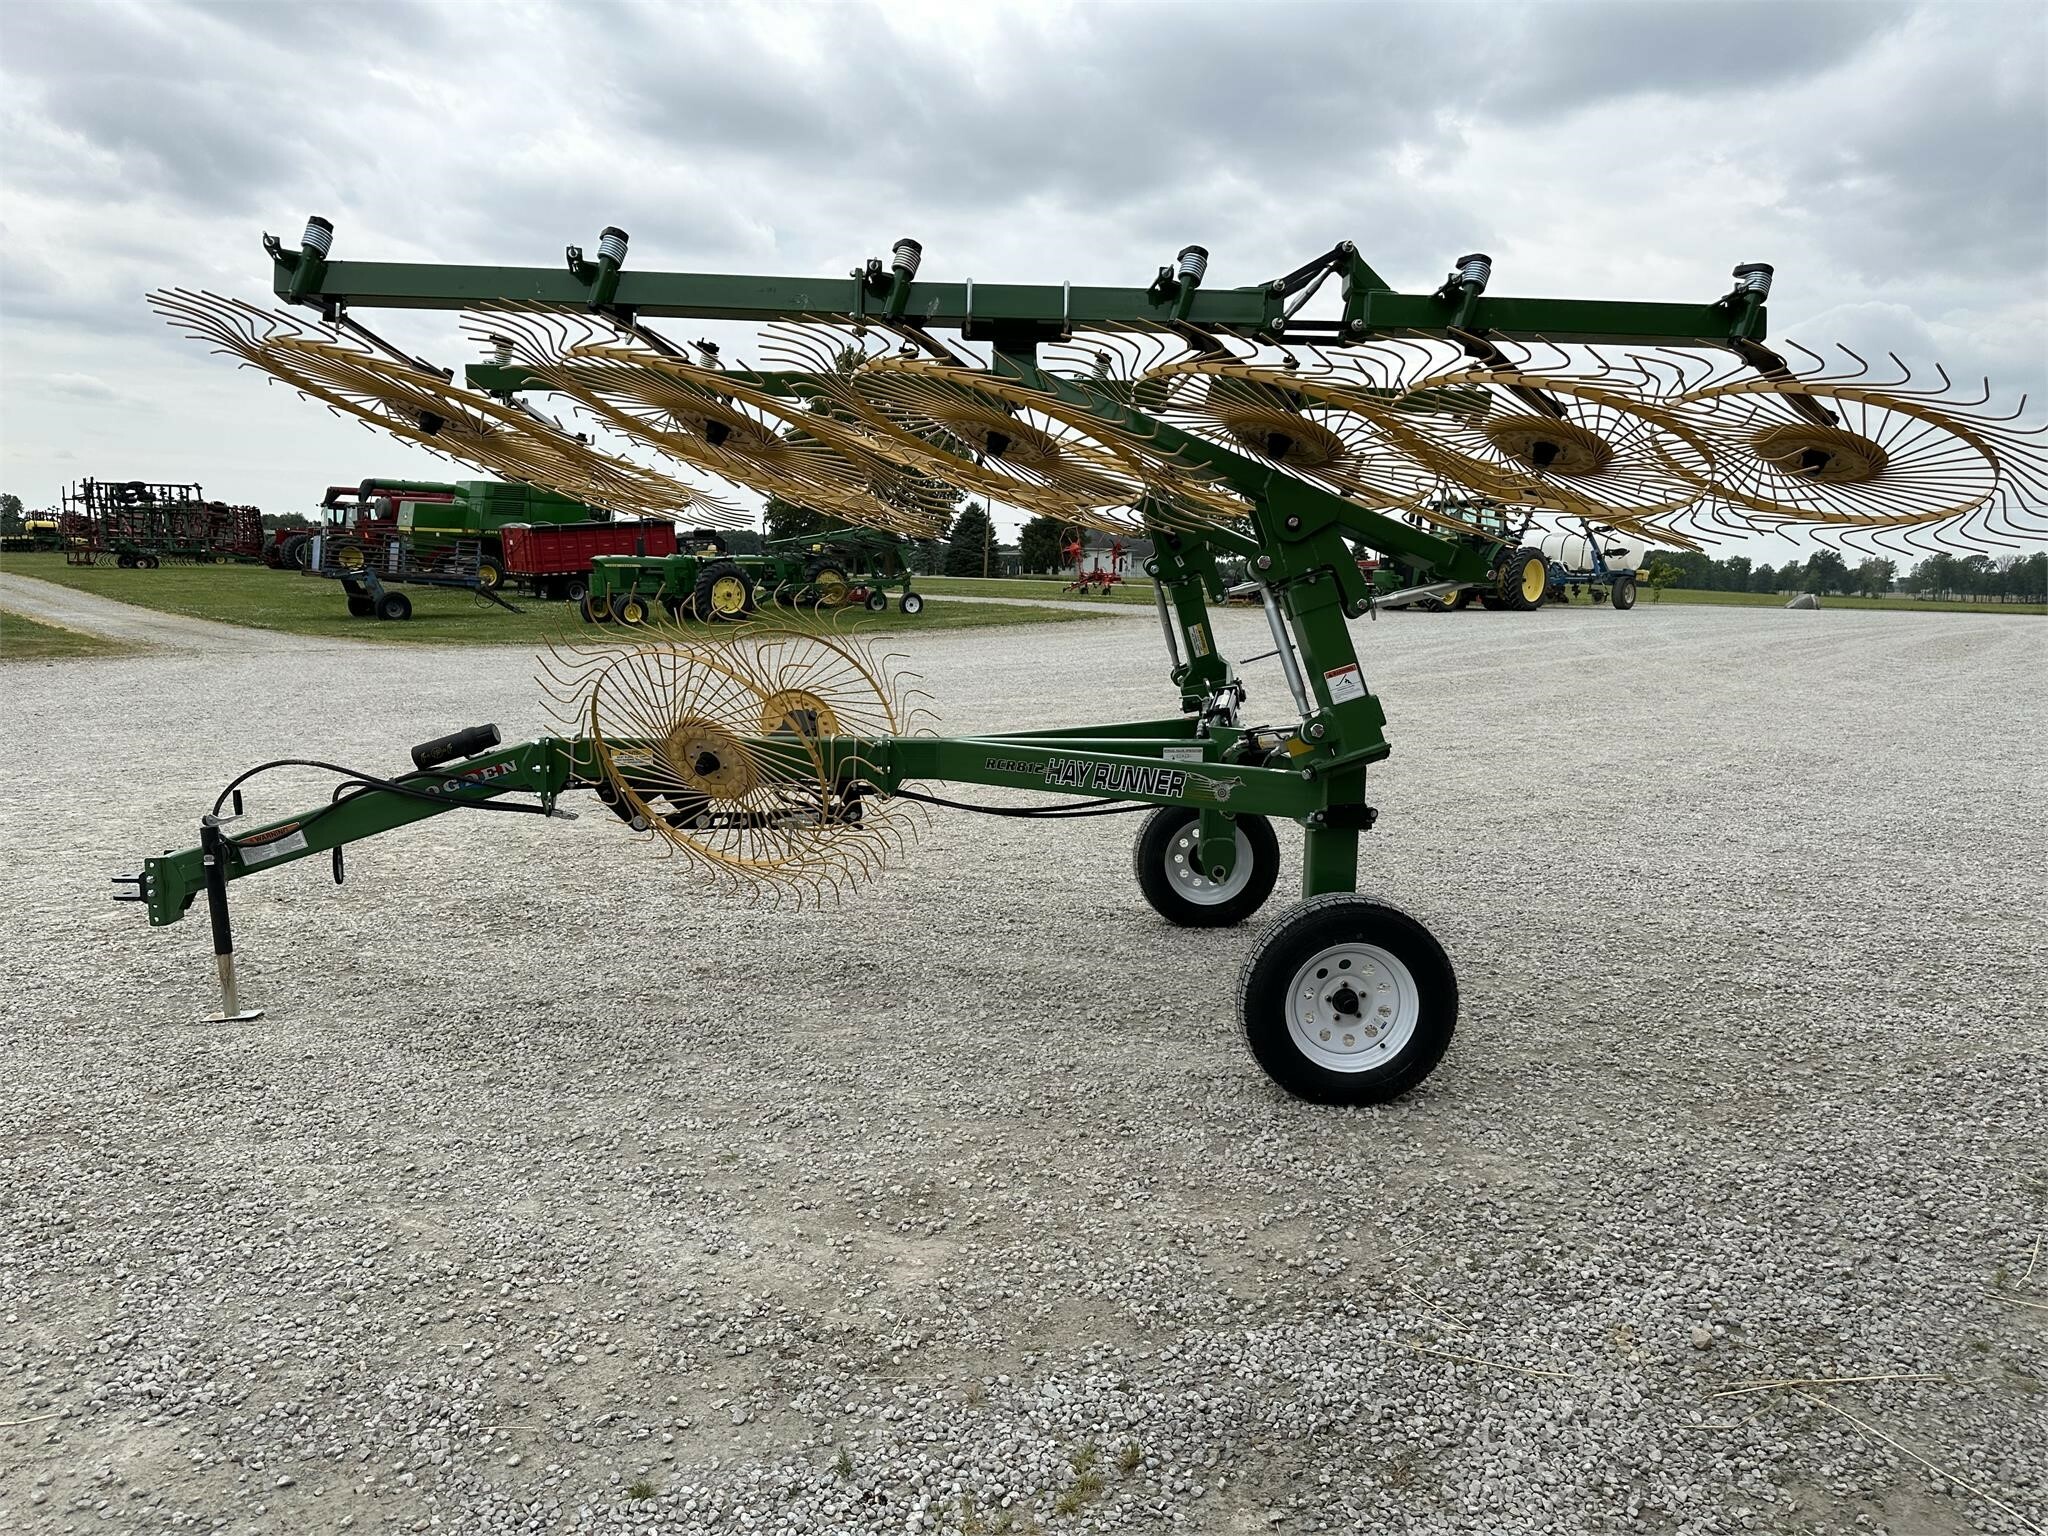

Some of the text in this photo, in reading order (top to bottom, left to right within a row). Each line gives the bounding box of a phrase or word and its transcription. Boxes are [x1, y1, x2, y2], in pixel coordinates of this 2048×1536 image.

[985, 758, 1187, 798] RCR812 HAY RUNNER
